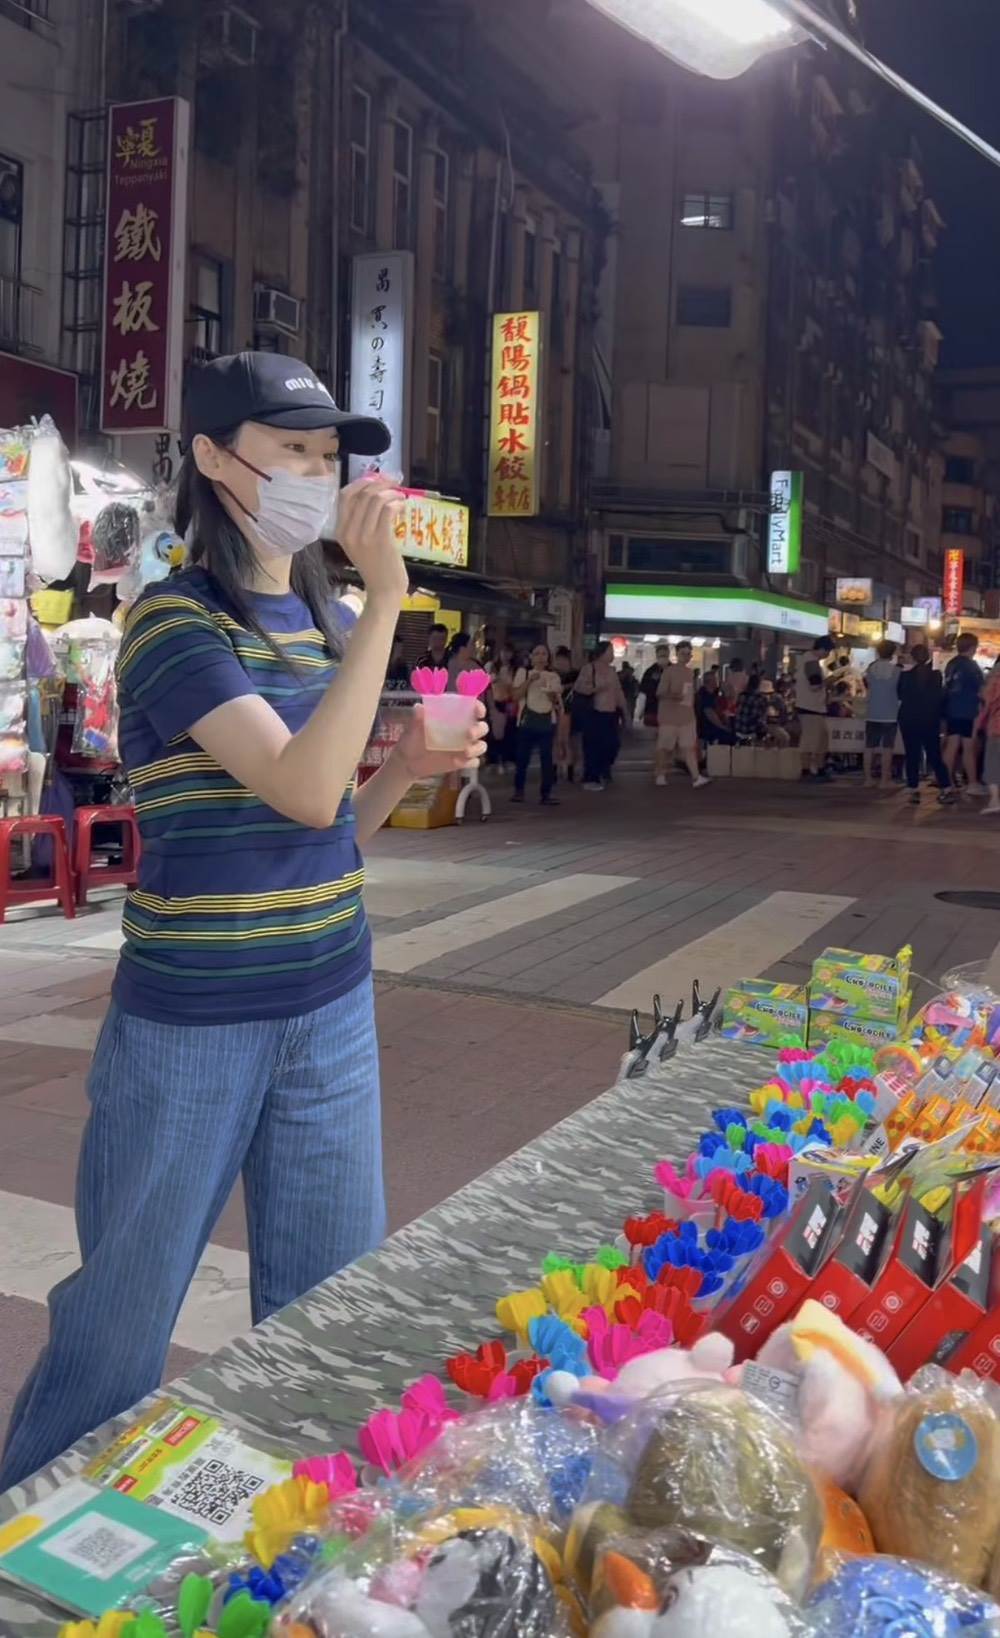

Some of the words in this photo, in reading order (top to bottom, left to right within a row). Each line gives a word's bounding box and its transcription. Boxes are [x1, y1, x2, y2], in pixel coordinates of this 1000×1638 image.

[109, 202, 162, 411] 鐵板燒
[493, 315, 533, 481] 馥陽鍋貼水餃
[770, 478, 789, 565] FalyMart
